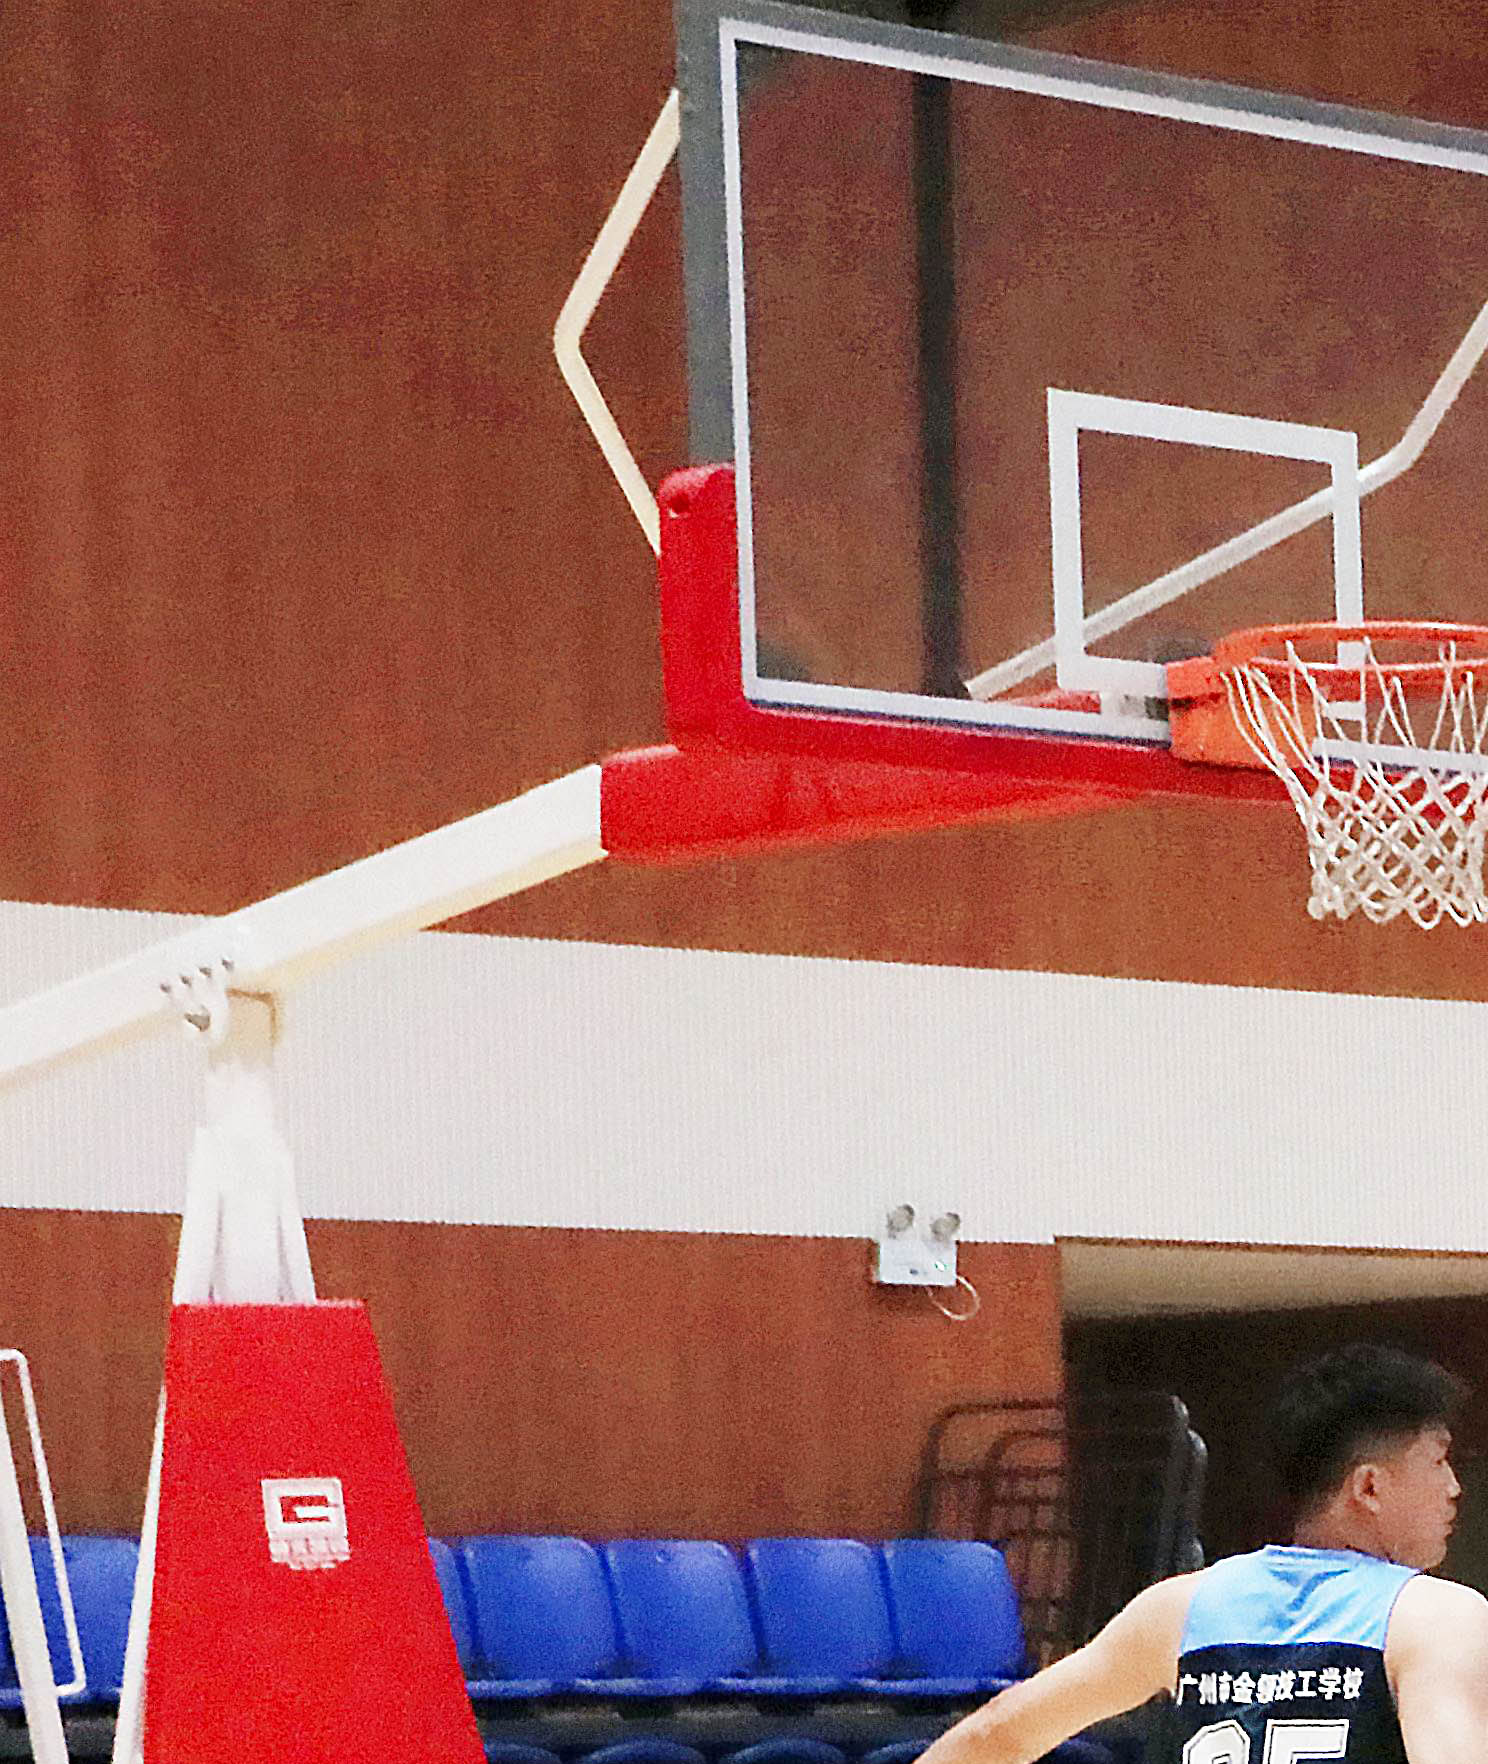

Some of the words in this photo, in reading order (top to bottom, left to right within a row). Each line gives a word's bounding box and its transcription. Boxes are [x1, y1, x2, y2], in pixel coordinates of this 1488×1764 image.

[1177, 1666, 1365, 1706] 广州市金领技工学校
